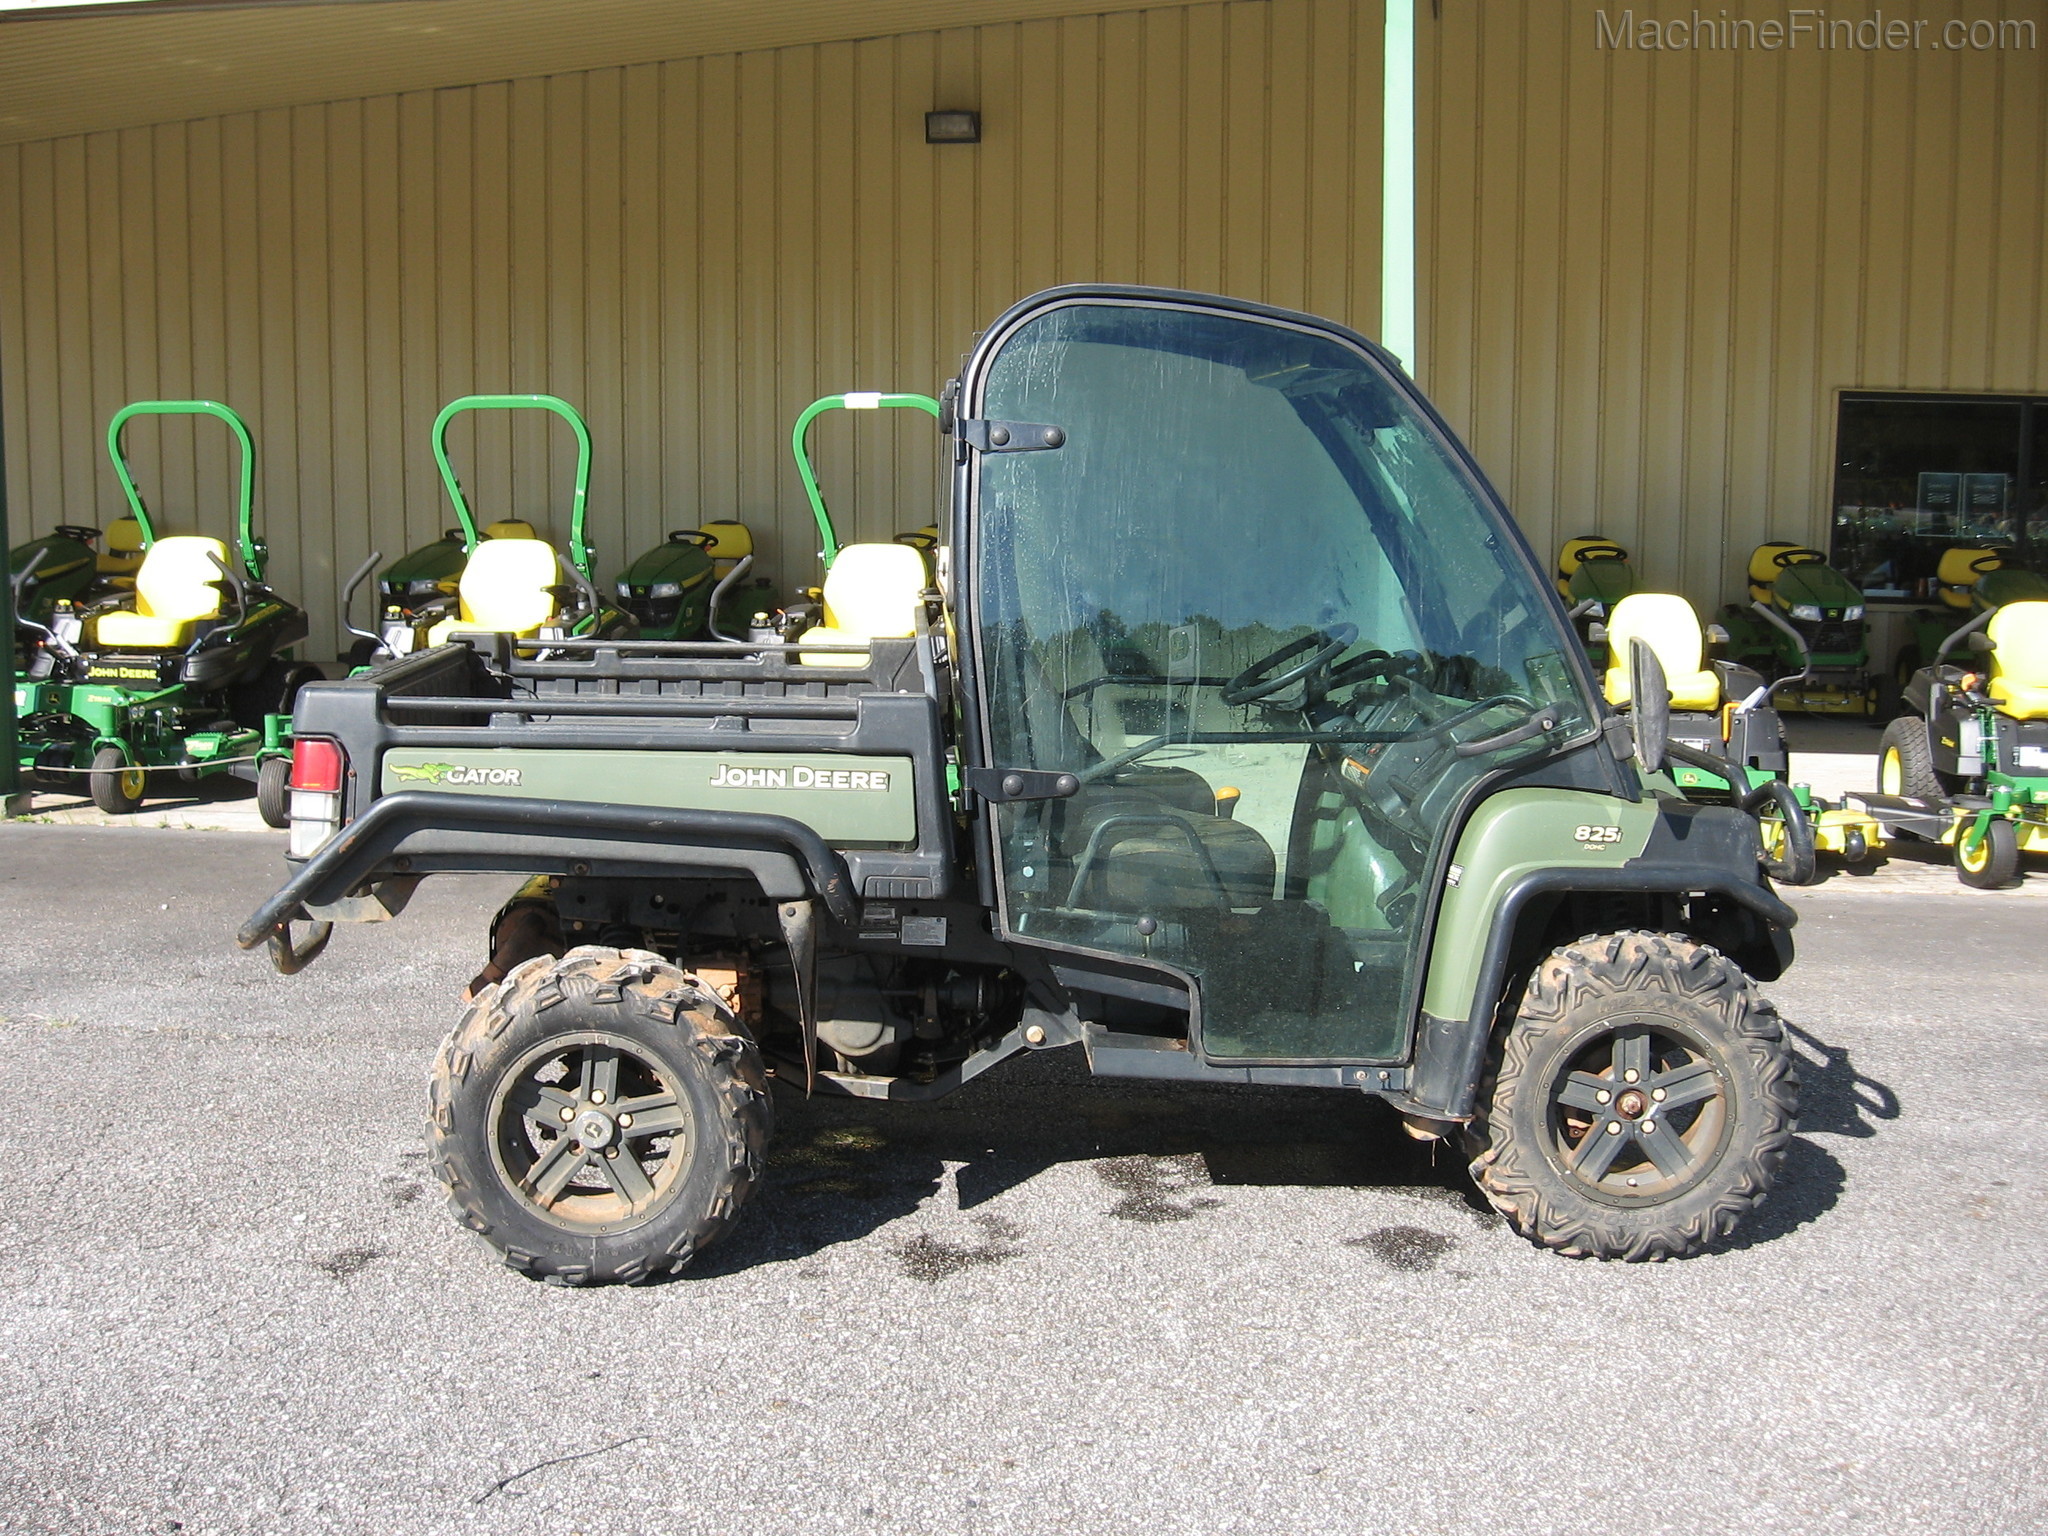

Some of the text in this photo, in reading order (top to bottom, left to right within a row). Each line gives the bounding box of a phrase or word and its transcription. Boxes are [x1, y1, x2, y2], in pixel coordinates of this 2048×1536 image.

[87, 666, 157, 679] JOHN DEERE
[446, 765, 522, 786] GATOR
[710, 764, 889, 790] JOHN DEERE
[1574, 825, 1623, 843] 825i
